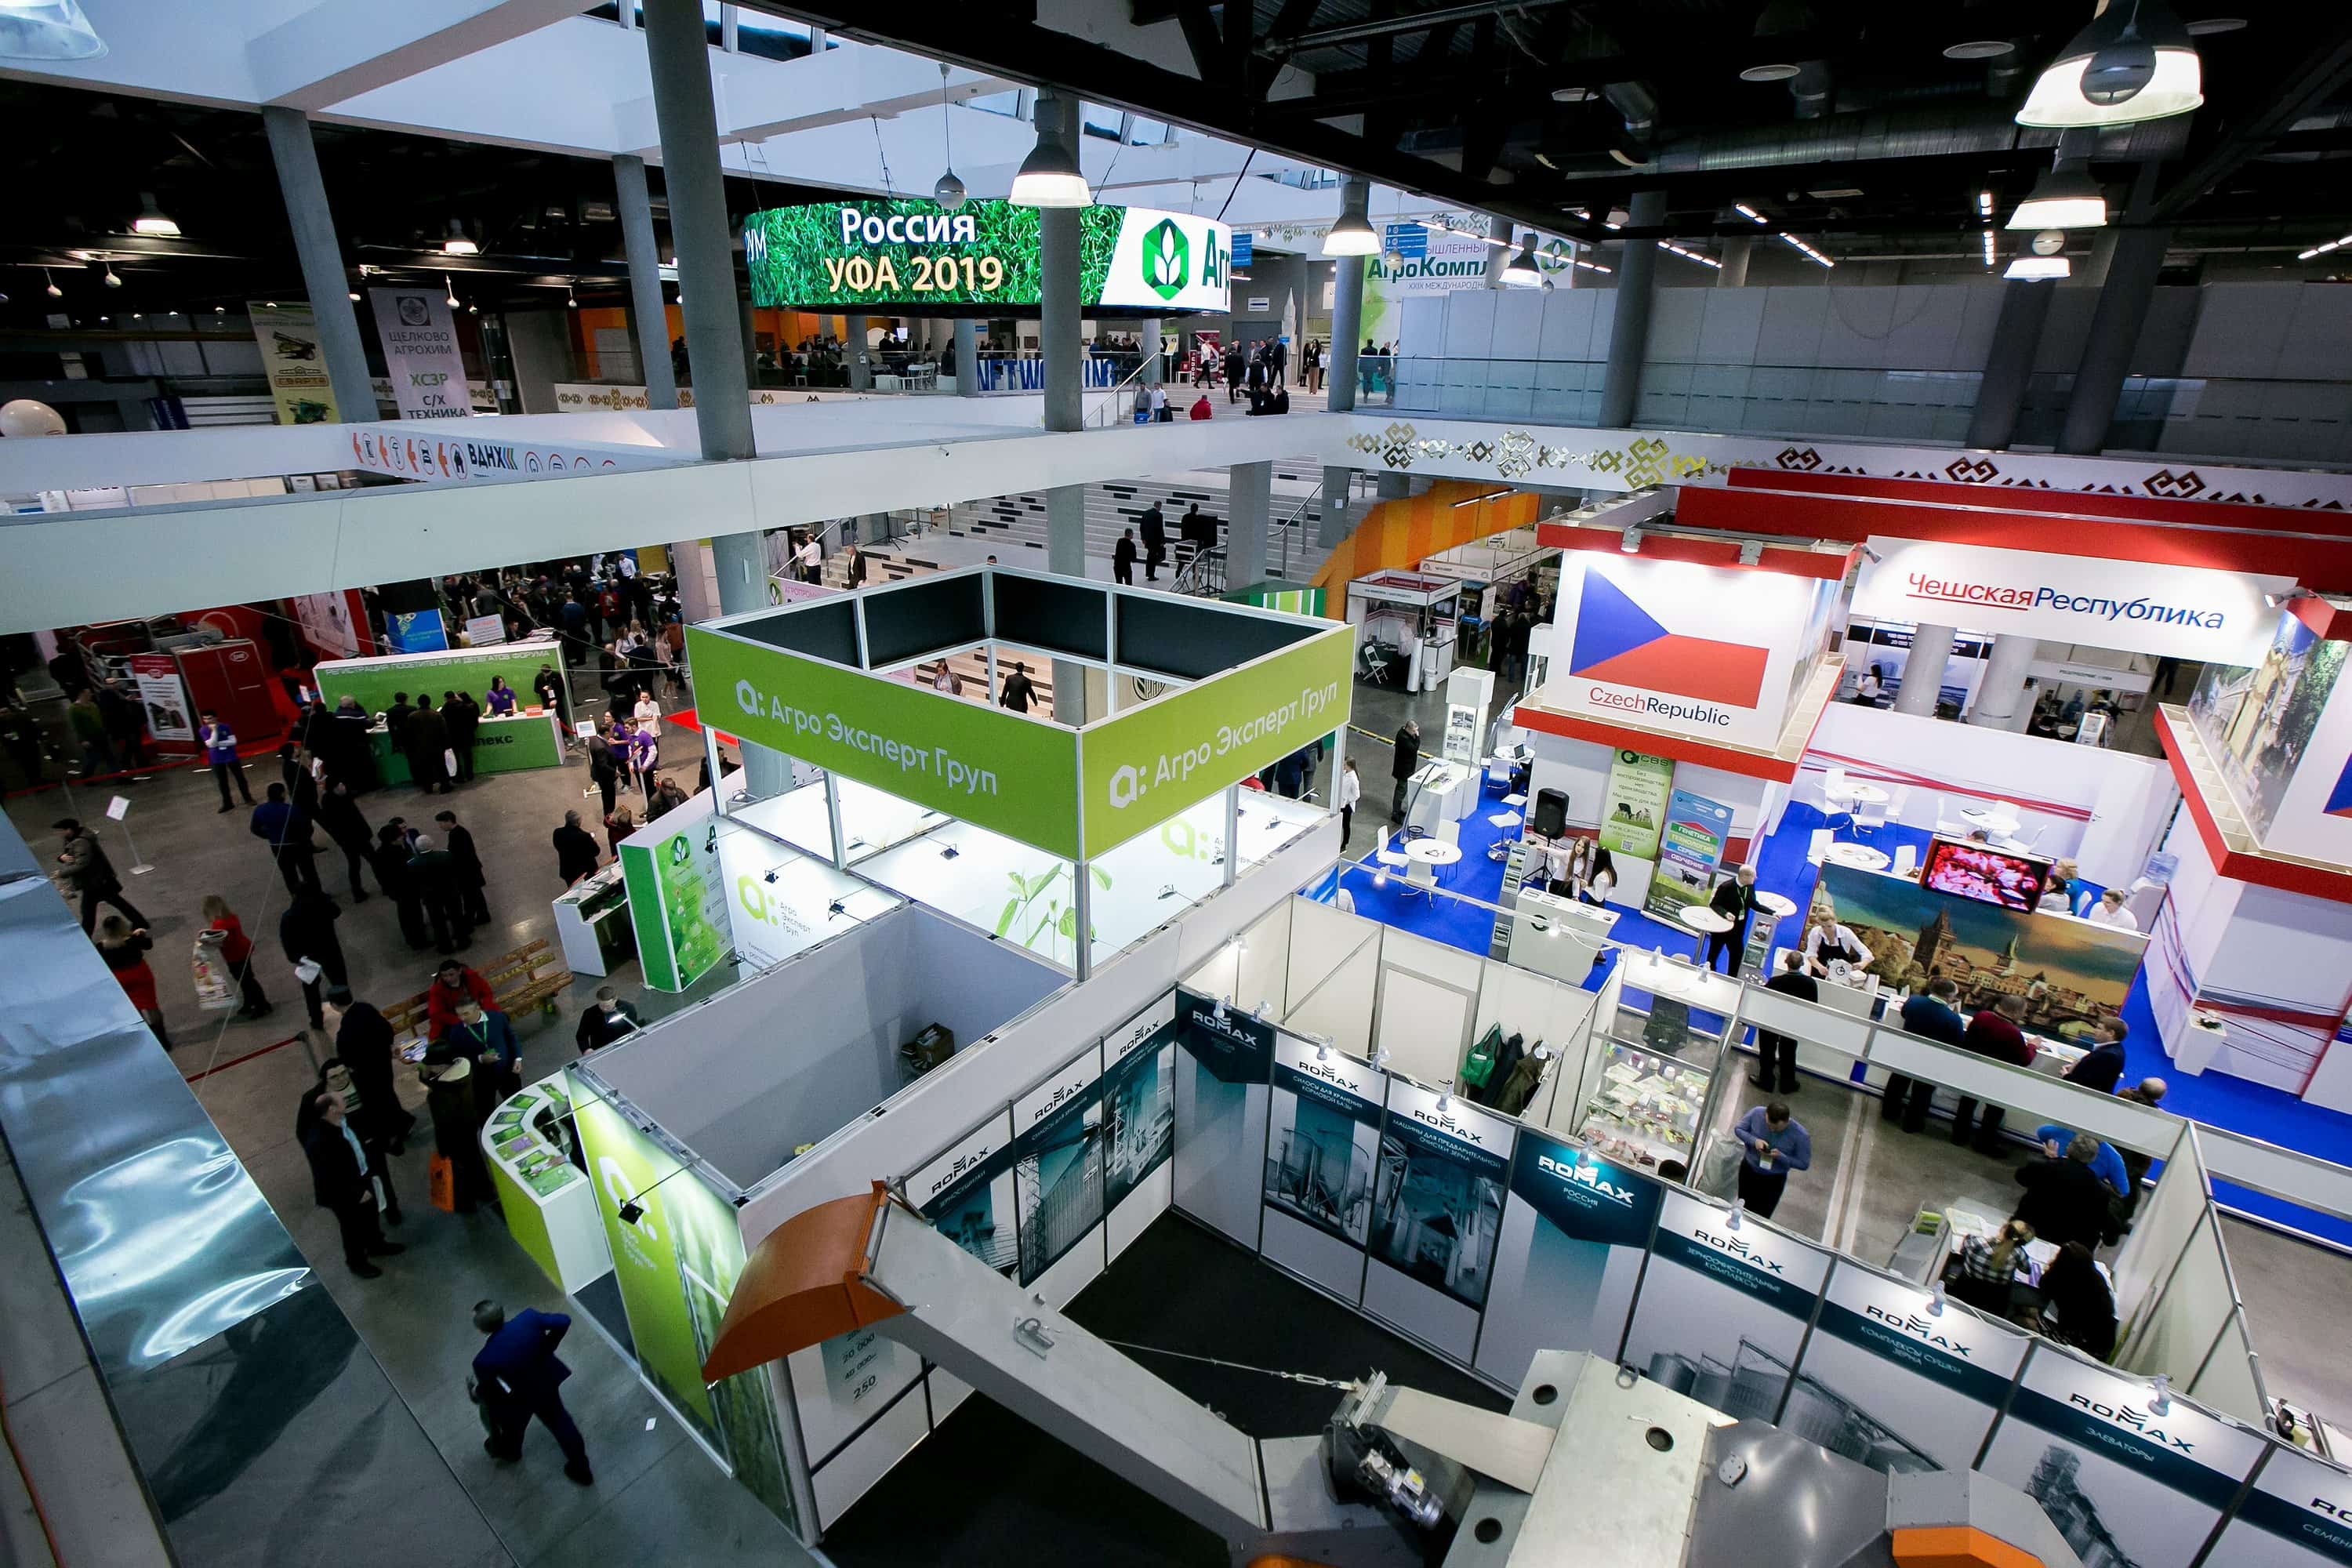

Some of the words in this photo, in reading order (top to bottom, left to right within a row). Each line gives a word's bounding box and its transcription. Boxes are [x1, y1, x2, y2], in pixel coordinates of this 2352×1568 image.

[841, 209, 975, 244] Россия
[826, 256, 900, 292] УФА
[911, 256, 1004, 292] 2019
[1367, 256, 1487, 284] АгроКомпл
[1425, 281, 1486, 290] МЕЖДУНАРОДН
[389, 332, 449, 342] ЩЕЛКОВО
[394, 344, 452, 354] АГРОХИМ
[408, 408, 468, 419] ТЕХНИКА
[467, 443, 505, 470] ВДНХ
[326, 664, 389, 676] РЕГИСТРАЦИЯ
[513, 651, 550, 660] ФОРУМА
[771, 695, 822, 735] Агро
[826, 713, 929, 772] Эксперт
[935, 747, 998, 796] Груп
[1154, 742, 1210, 788] Агро
[1216, 700, 1298, 756] Эксперт
[1301, 682, 1338, 718] Груп
[1640, 755, 1669, 767] CBS
[1119, 1020, 1160, 1056] ROMAX
[1192, 1010, 1258, 1047] ROMAX
[1299, 1061, 1359, 1092] ROMAX
[1035, 1080, 1083, 1121] ROMAX
[1414, 1109, 1483, 1145] ROMAX
[931, 1146, 989, 1194] ROMAX
[1538, 1155, 1635, 1204] ROMAX
[1563, 1187, 1599, 1207] РОССИЯ
[1694, 1229, 1784, 1275] ROMAX
[1866, 1305, 1972, 1358] ROMAX
[853, 1374, 877, 1399] 250
[2070, 1392, 2196, 1455] ROMAX
[2085, 1426, 2155, 1462] ЭЛЕВАТОРЫ
